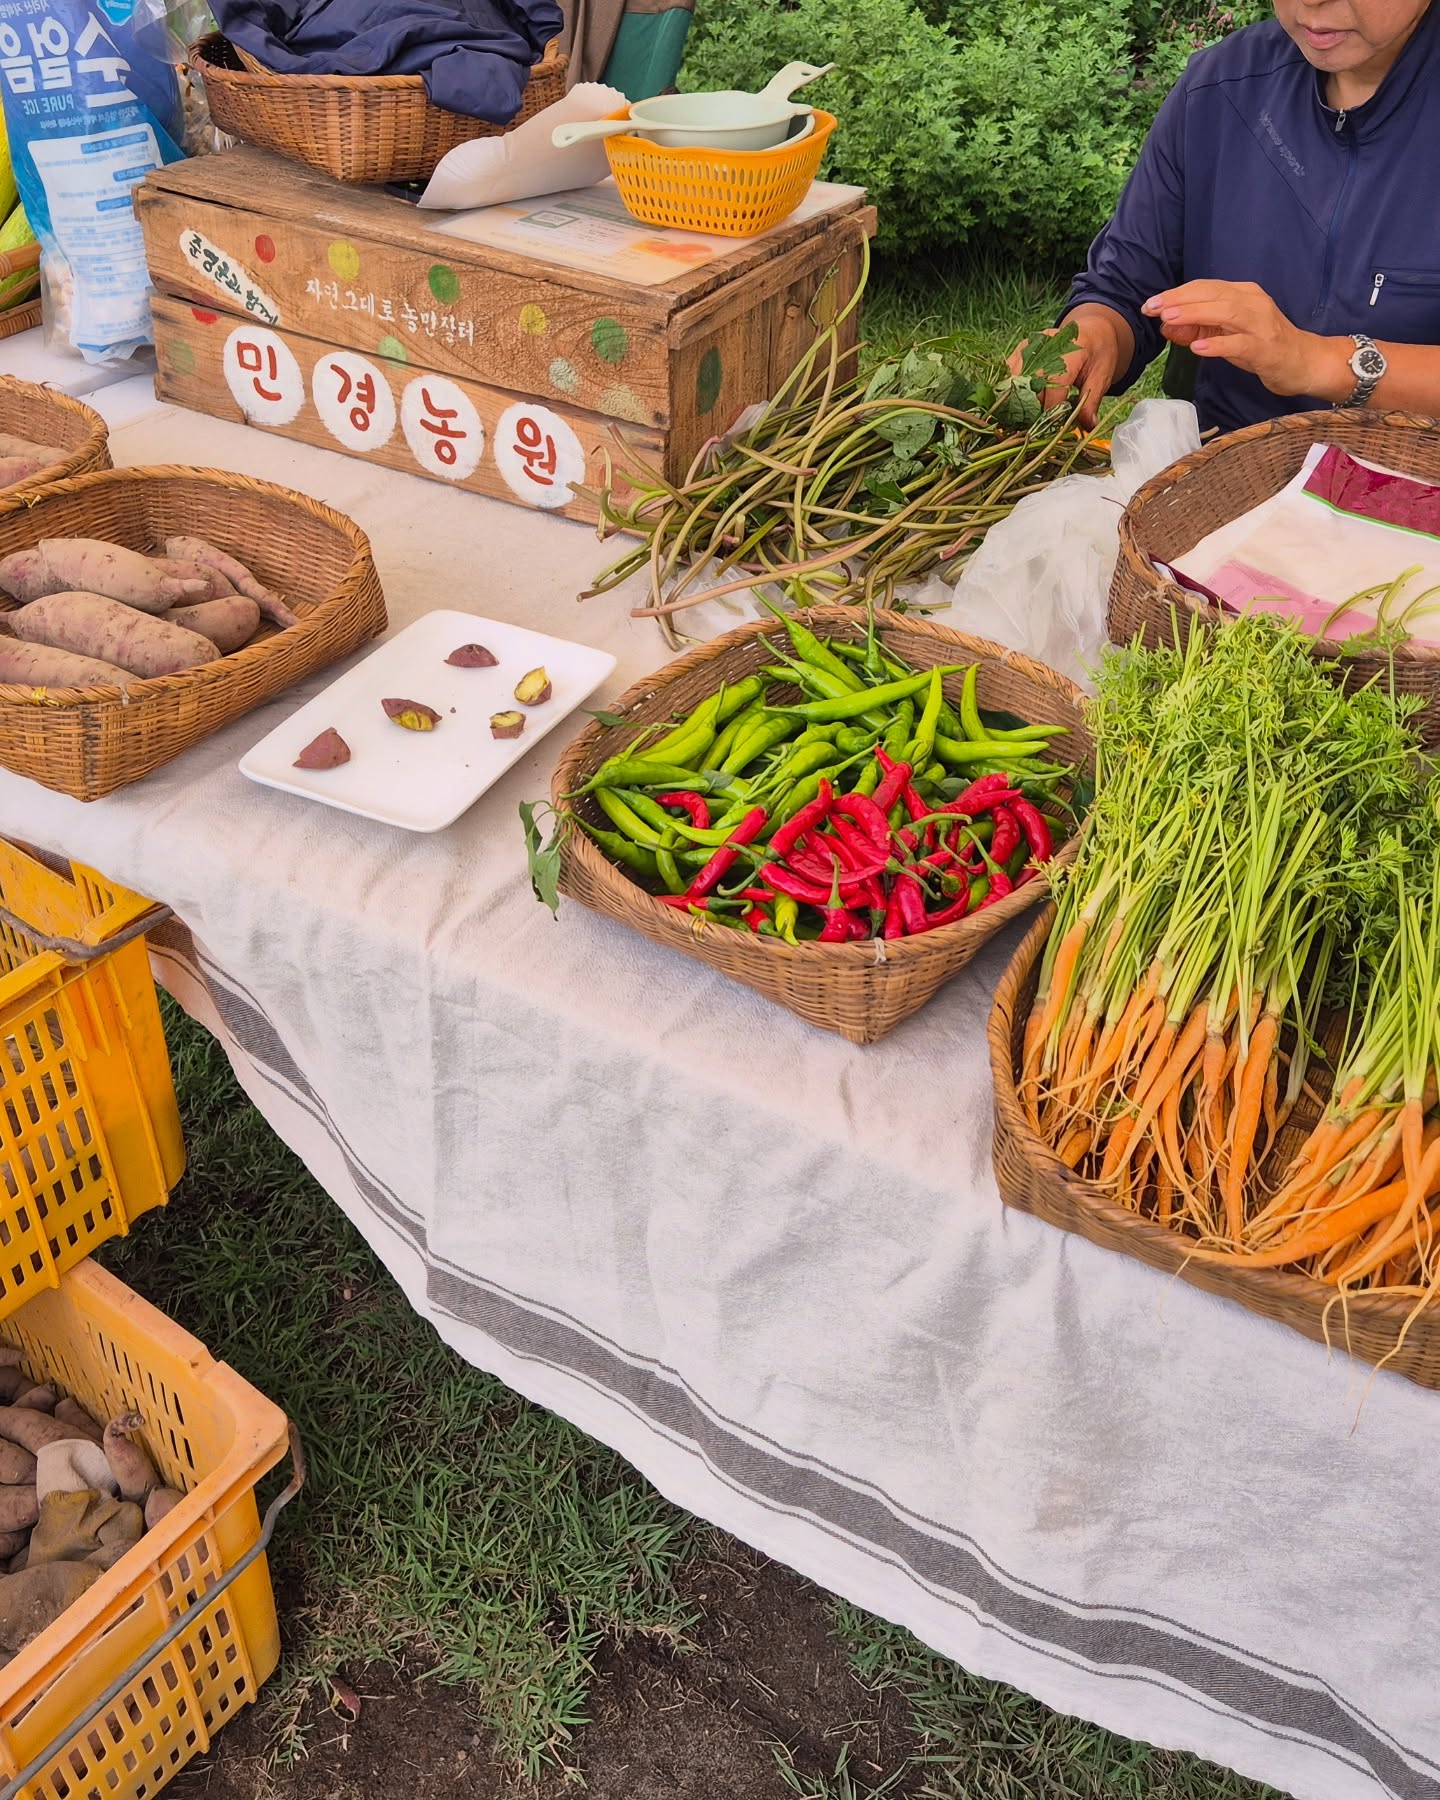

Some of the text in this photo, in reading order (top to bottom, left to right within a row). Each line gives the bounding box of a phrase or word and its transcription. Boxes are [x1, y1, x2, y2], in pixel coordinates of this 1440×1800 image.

[304, 277, 339, 310] 자연
[341, 290, 396, 322] 그대로
[236, 339, 557, 487] 민경농원
